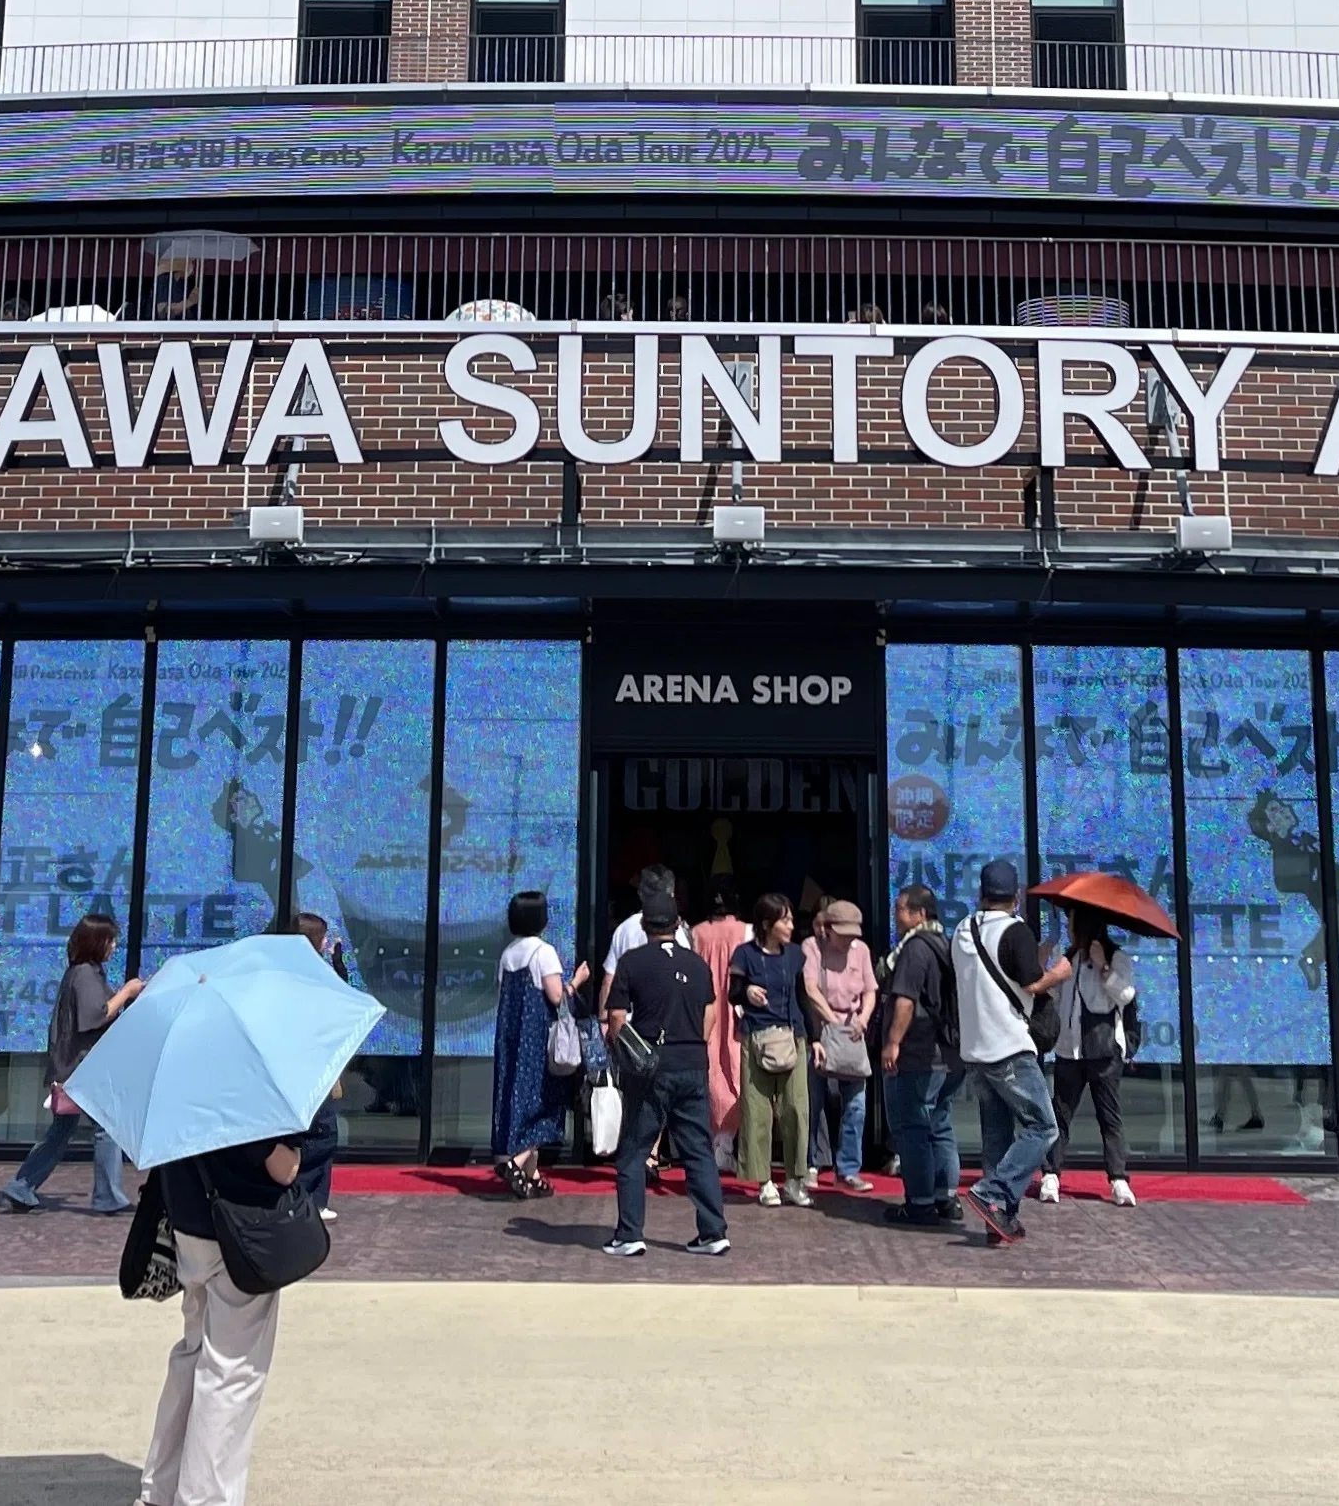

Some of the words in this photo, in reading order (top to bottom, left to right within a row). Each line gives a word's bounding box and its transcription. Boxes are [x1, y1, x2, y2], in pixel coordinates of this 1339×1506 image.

[234, 137, 368, 169] Presents
[390, 128, 549, 166] Kazumasa
[556, 131, 624, 164] Oda
[633, 131, 699, 164] Tour
[704, 129, 773, 164] 2025
[437, 332, 1258, 471] SUNTORY
[107, 662, 185, 681] Kazuasa
[615, 674, 740, 704] ARENA
[752, 674, 853, 705] SHOP
